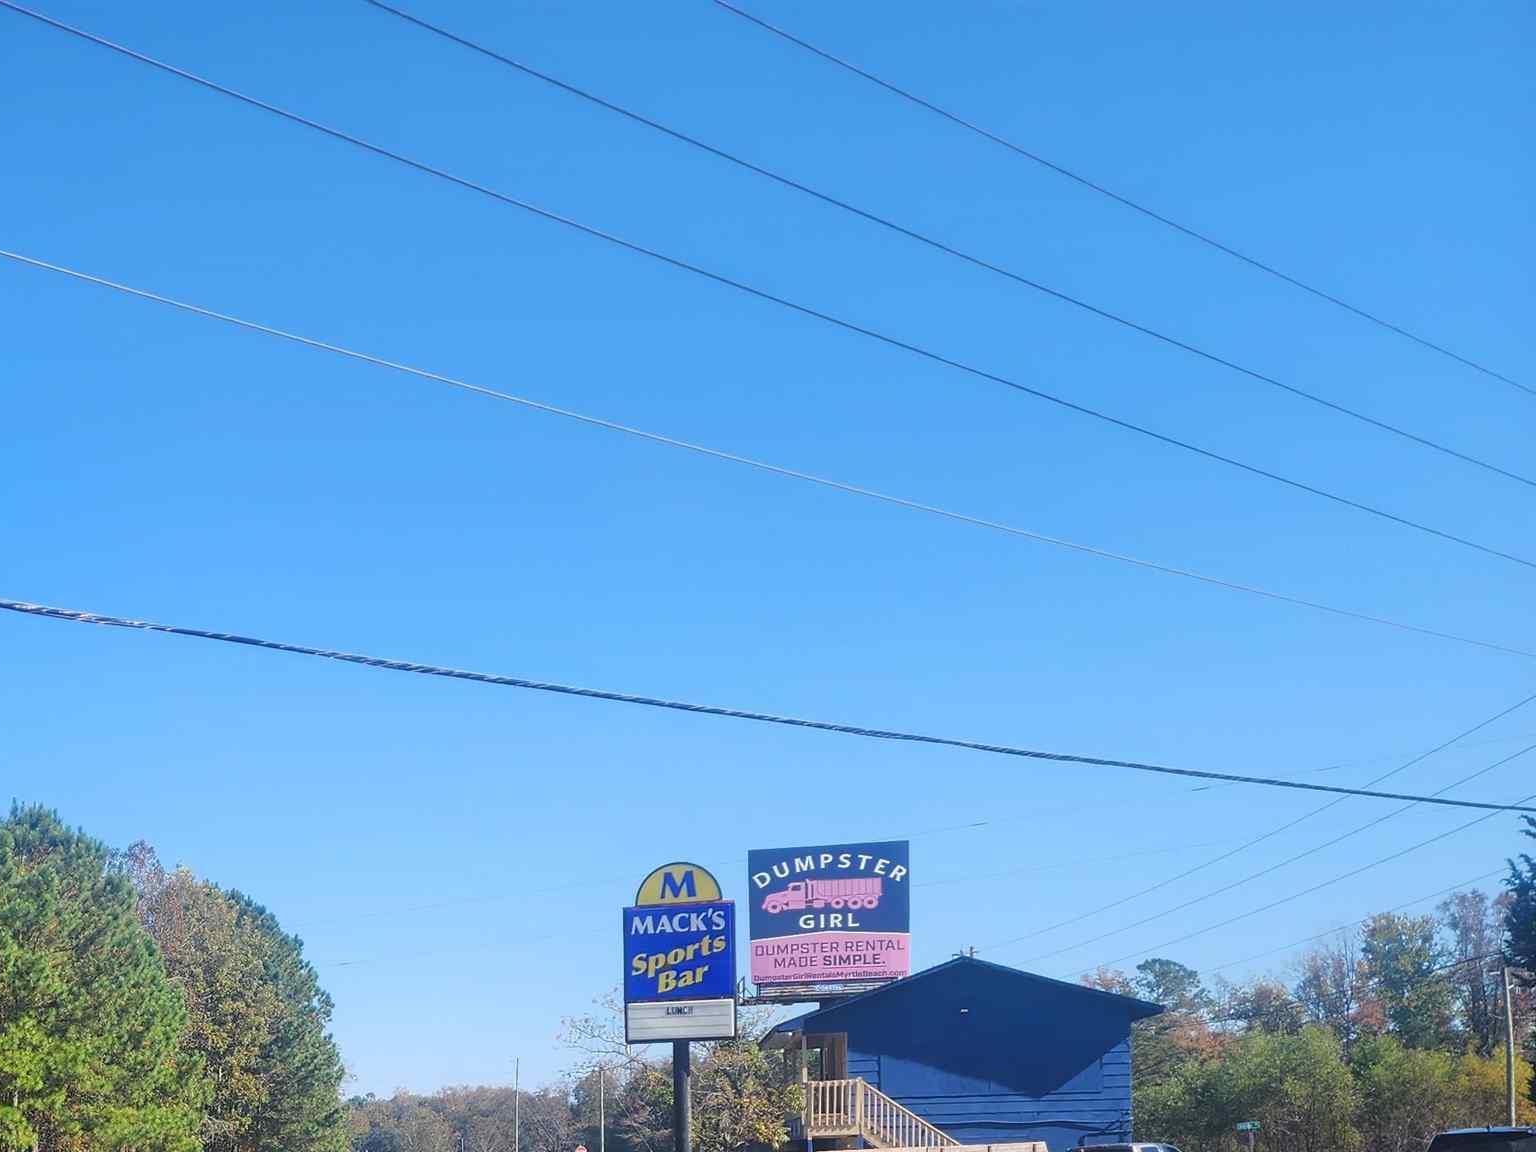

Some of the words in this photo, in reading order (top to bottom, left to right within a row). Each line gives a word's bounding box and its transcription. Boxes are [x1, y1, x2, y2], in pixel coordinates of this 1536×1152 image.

[752, 853, 907, 888] DUMPSTER
[660, 870, 697, 899] M
[631, 908, 726, 935] MACK'S
[799, 913, 860, 929] GIRL
[631, 935, 726, 978] Sports
[755, 942, 839, 957] DUMPSTER
[845, 940, 905, 952] RENTAL
[774, 956, 818, 969] MADE
[823, 954, 886, 967] SIMPLE.
[657, 965, 710, 993] Bar
[666, 1006, 694, 1016] LUNCH
